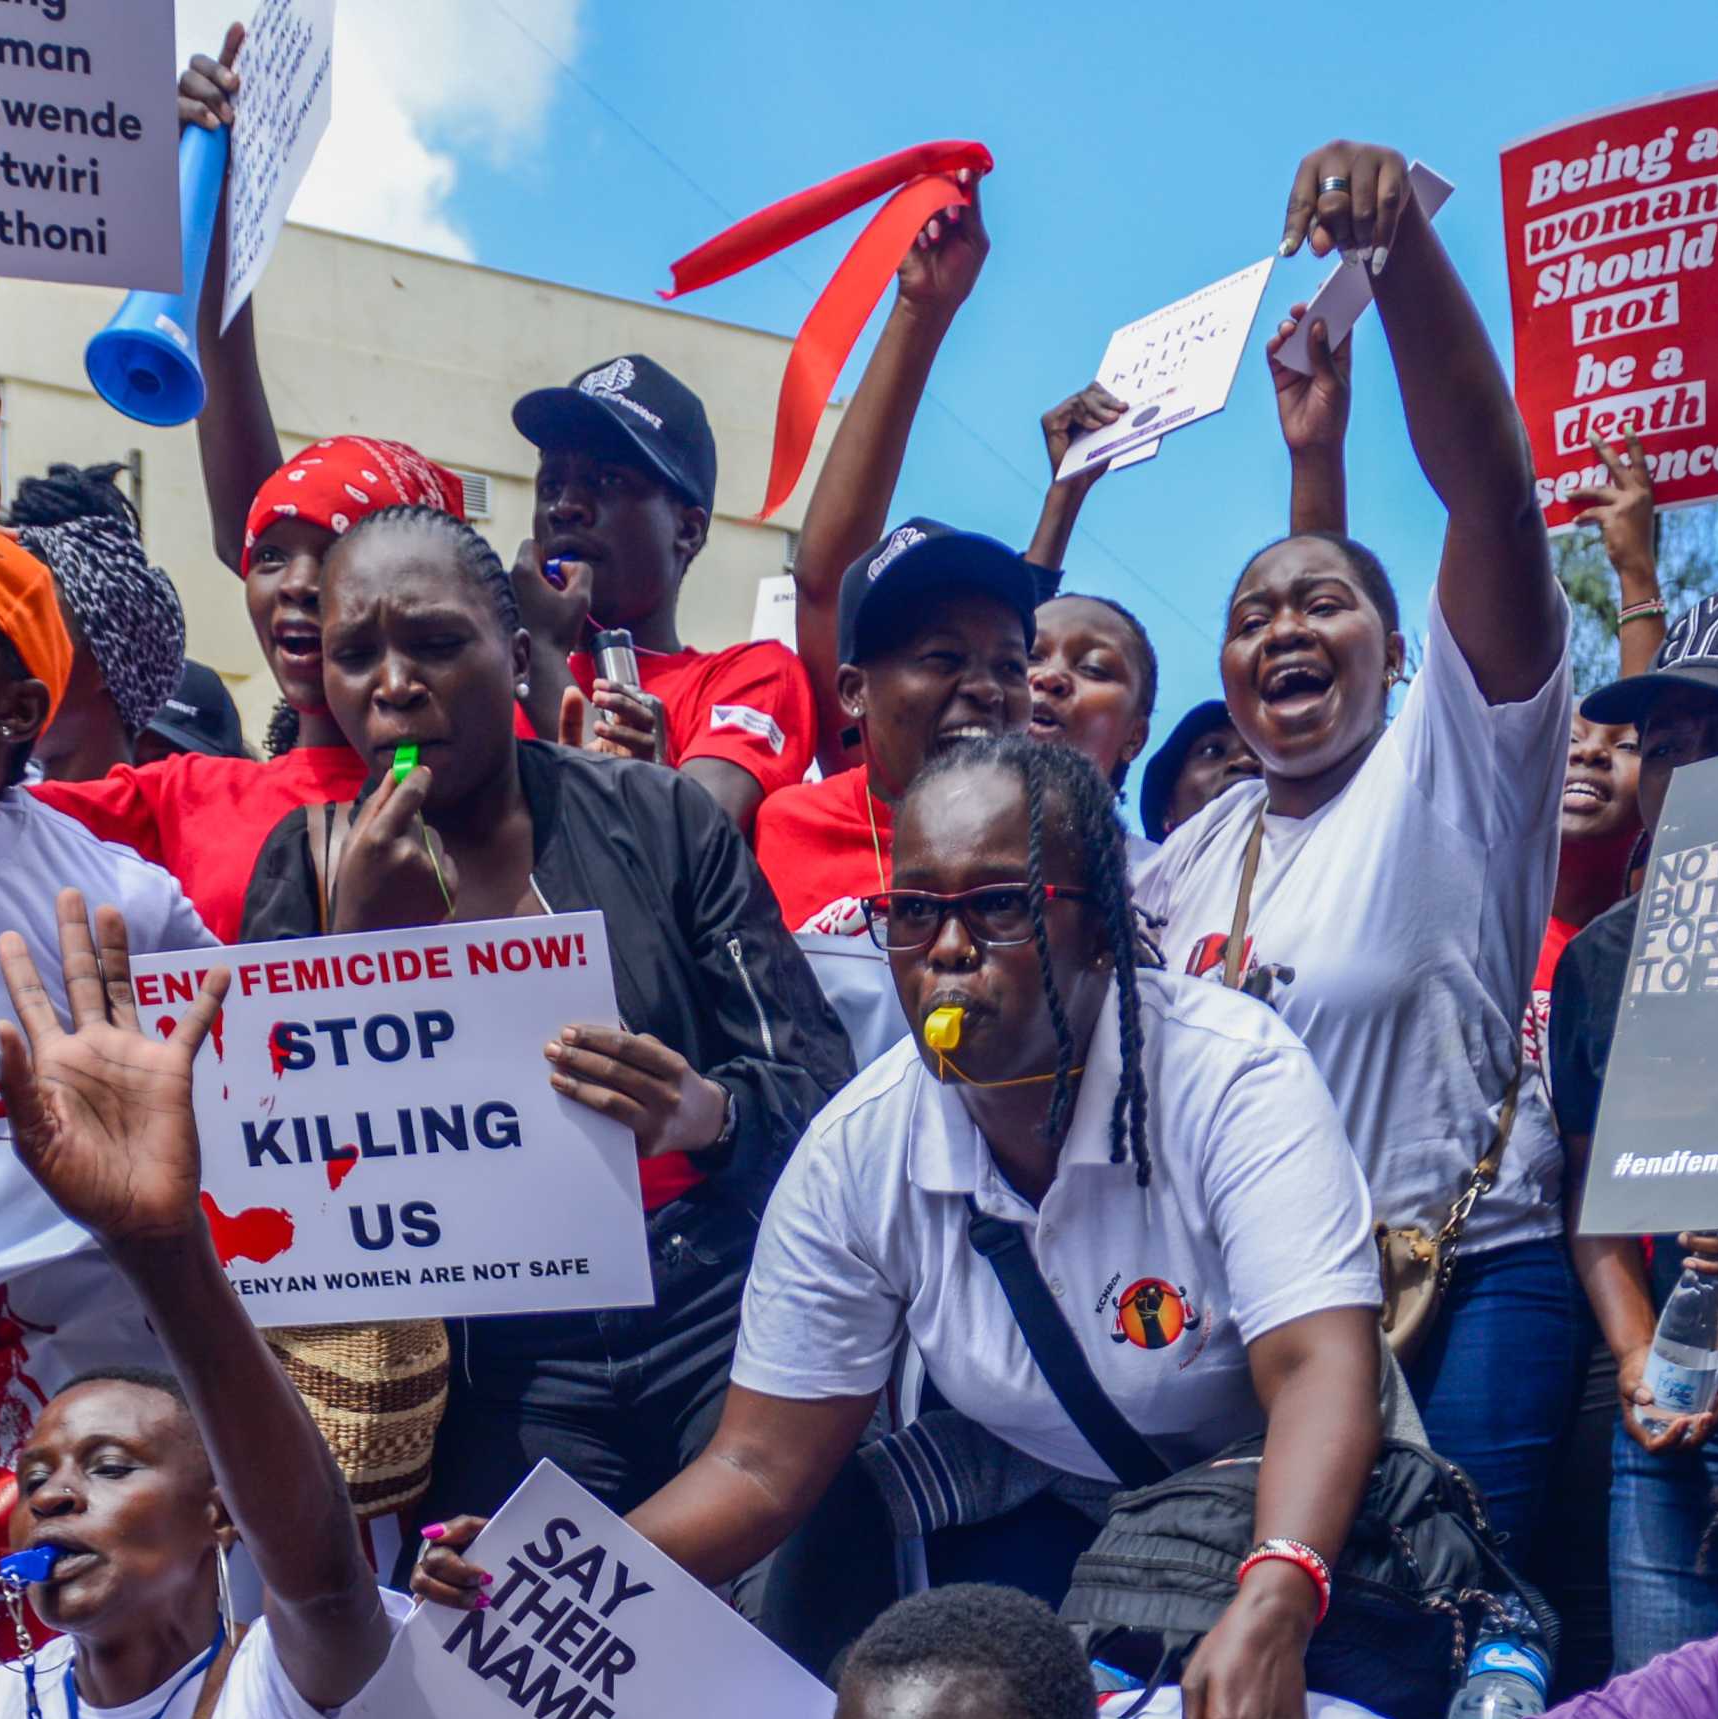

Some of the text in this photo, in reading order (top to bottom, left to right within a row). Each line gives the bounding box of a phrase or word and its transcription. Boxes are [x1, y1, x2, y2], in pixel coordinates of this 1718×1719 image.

[1527, 127, 1678, 207] Being
[1533, 224, 1718, 308] Should
[1580, 287, 1671, 340] not
[1573, 346, 1684, 398] be a
[1562, 386, 1701, 449] death
[239, 946, 453, 998] FEMICIDE
[466, 932, 589, 976] NOW!
[1635, 955, 1691, 993] TO
[280, 1008, 455, 1072] STOP
[240, 1100, 523, 1168] KILLING
[348, 1199, 442, 1251] US
[324, 1268, 412, 1291] WOMEN
[419, 1264, 466, 1285] ARE
[473, 1261, 522, 1282] NOT
[528, 1257, 591, 1278] SAFE
[523, 1516, 655, 1619] SAY
[489, 1556, 638, 1700] THEIR
